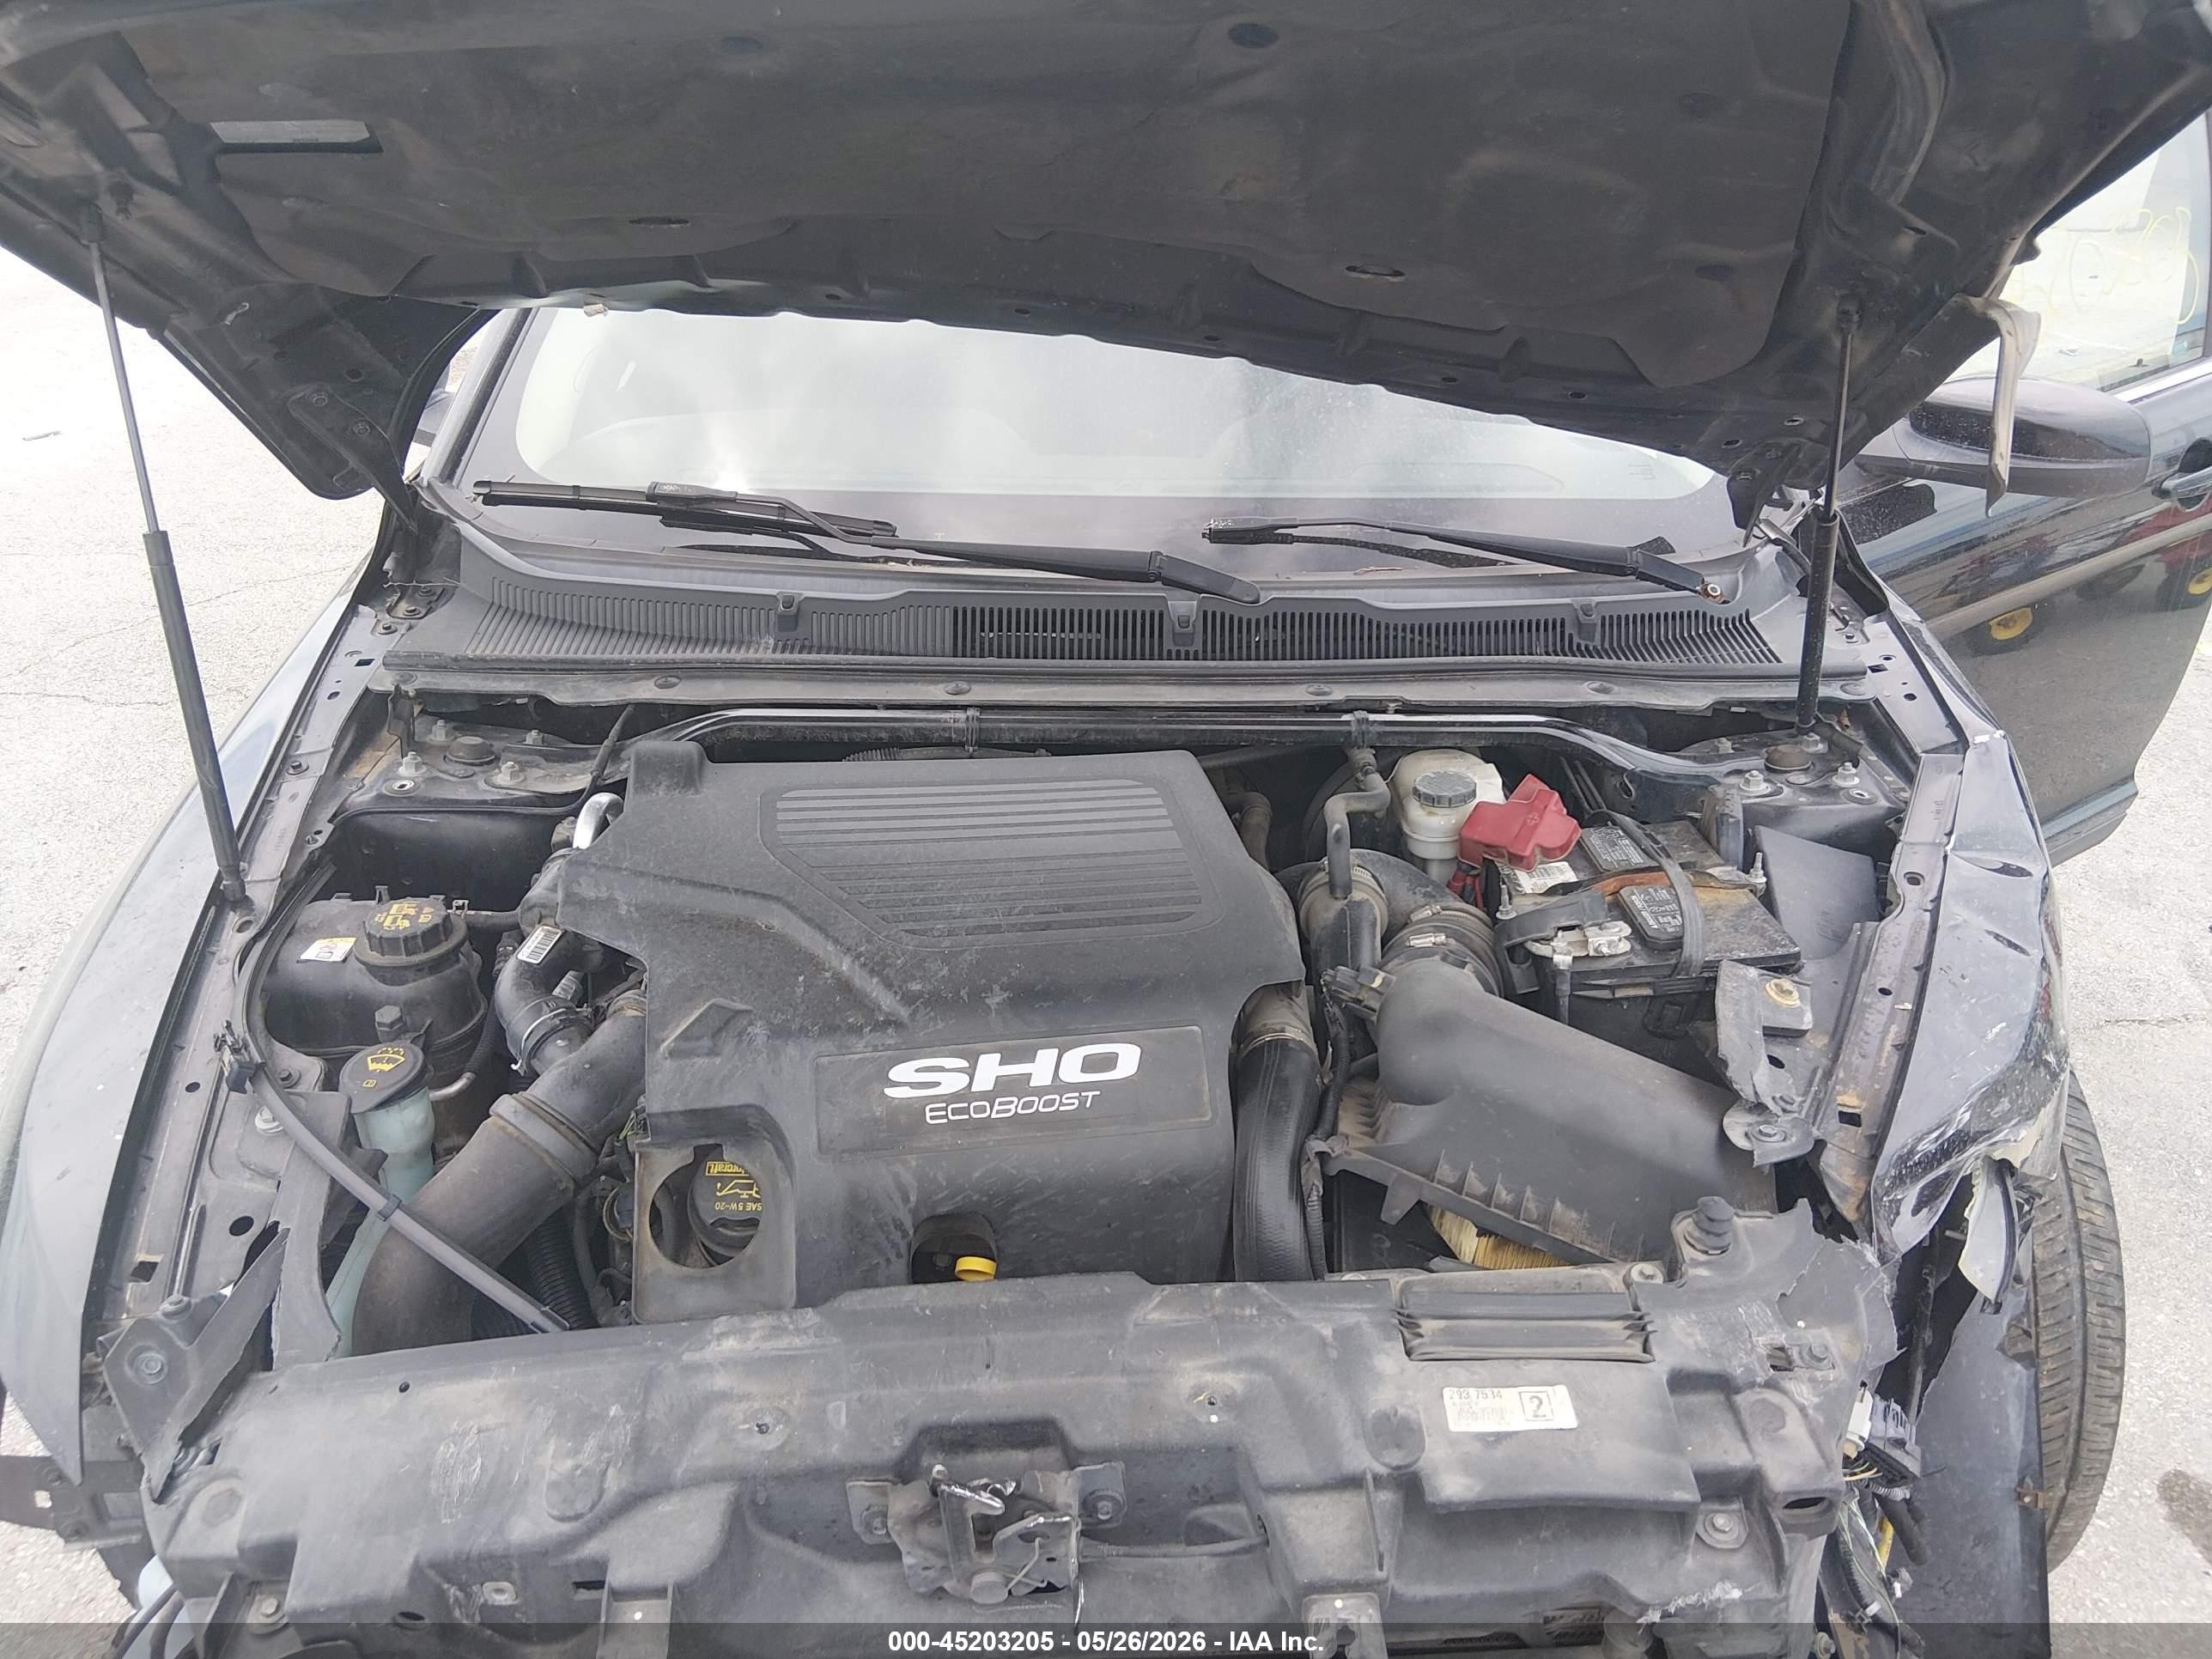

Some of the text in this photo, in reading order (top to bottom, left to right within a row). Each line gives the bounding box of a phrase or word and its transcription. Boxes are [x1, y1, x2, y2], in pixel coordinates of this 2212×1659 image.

[883, 1042, 1143, 1099] SHO
[714, 1202, 763, 1212] SAE 5W-20
